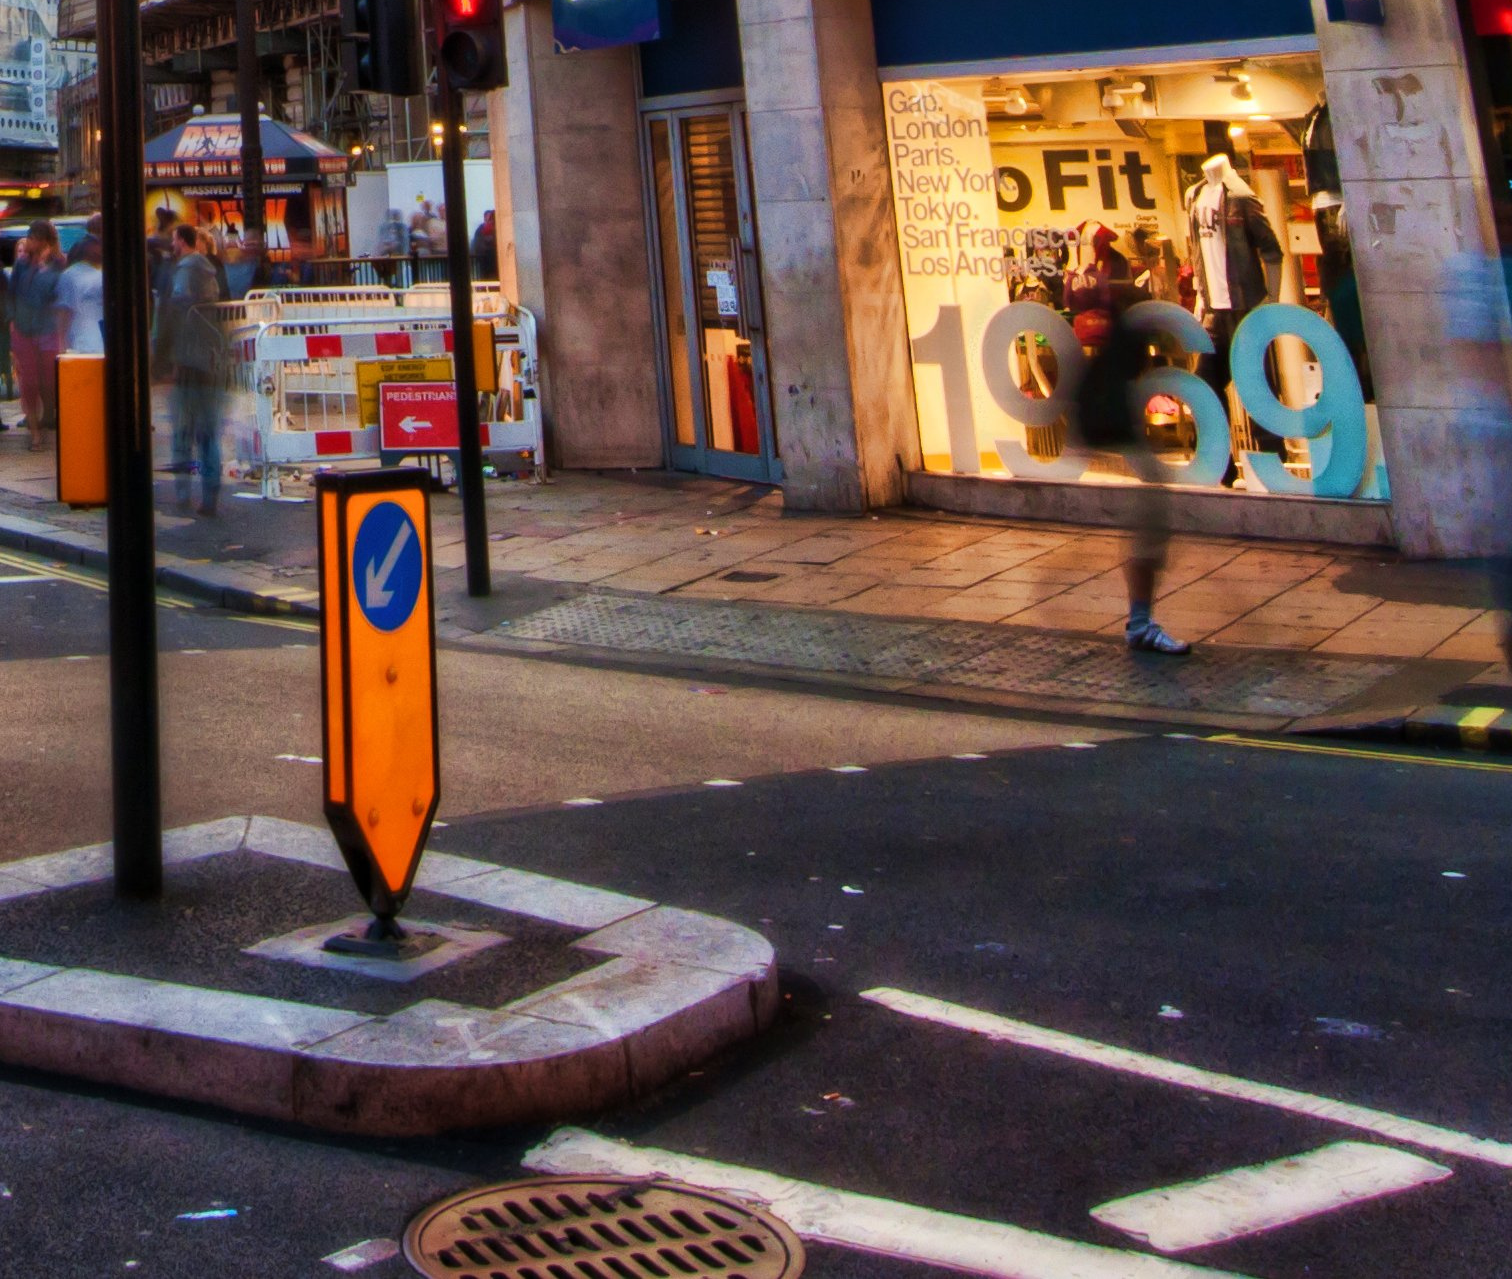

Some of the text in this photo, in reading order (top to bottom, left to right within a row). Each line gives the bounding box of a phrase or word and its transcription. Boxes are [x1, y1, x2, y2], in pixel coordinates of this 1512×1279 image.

[888, 89, 943, 115] Gap.
[174, 124, 243, 158] ROC
[890, 113, 988, 141] London.
[893, 142, 961, 168] Paris.
[897, 167, 1018, 194] New York.
[1042, 148, 1156, 211] Fit
[898, 196, 979, 226] Tokyo.
[903, 224, 949, 248] San
[907, 250, 1064, 282] Los Angeles.
[912, 301, 1368, 498] 1969
